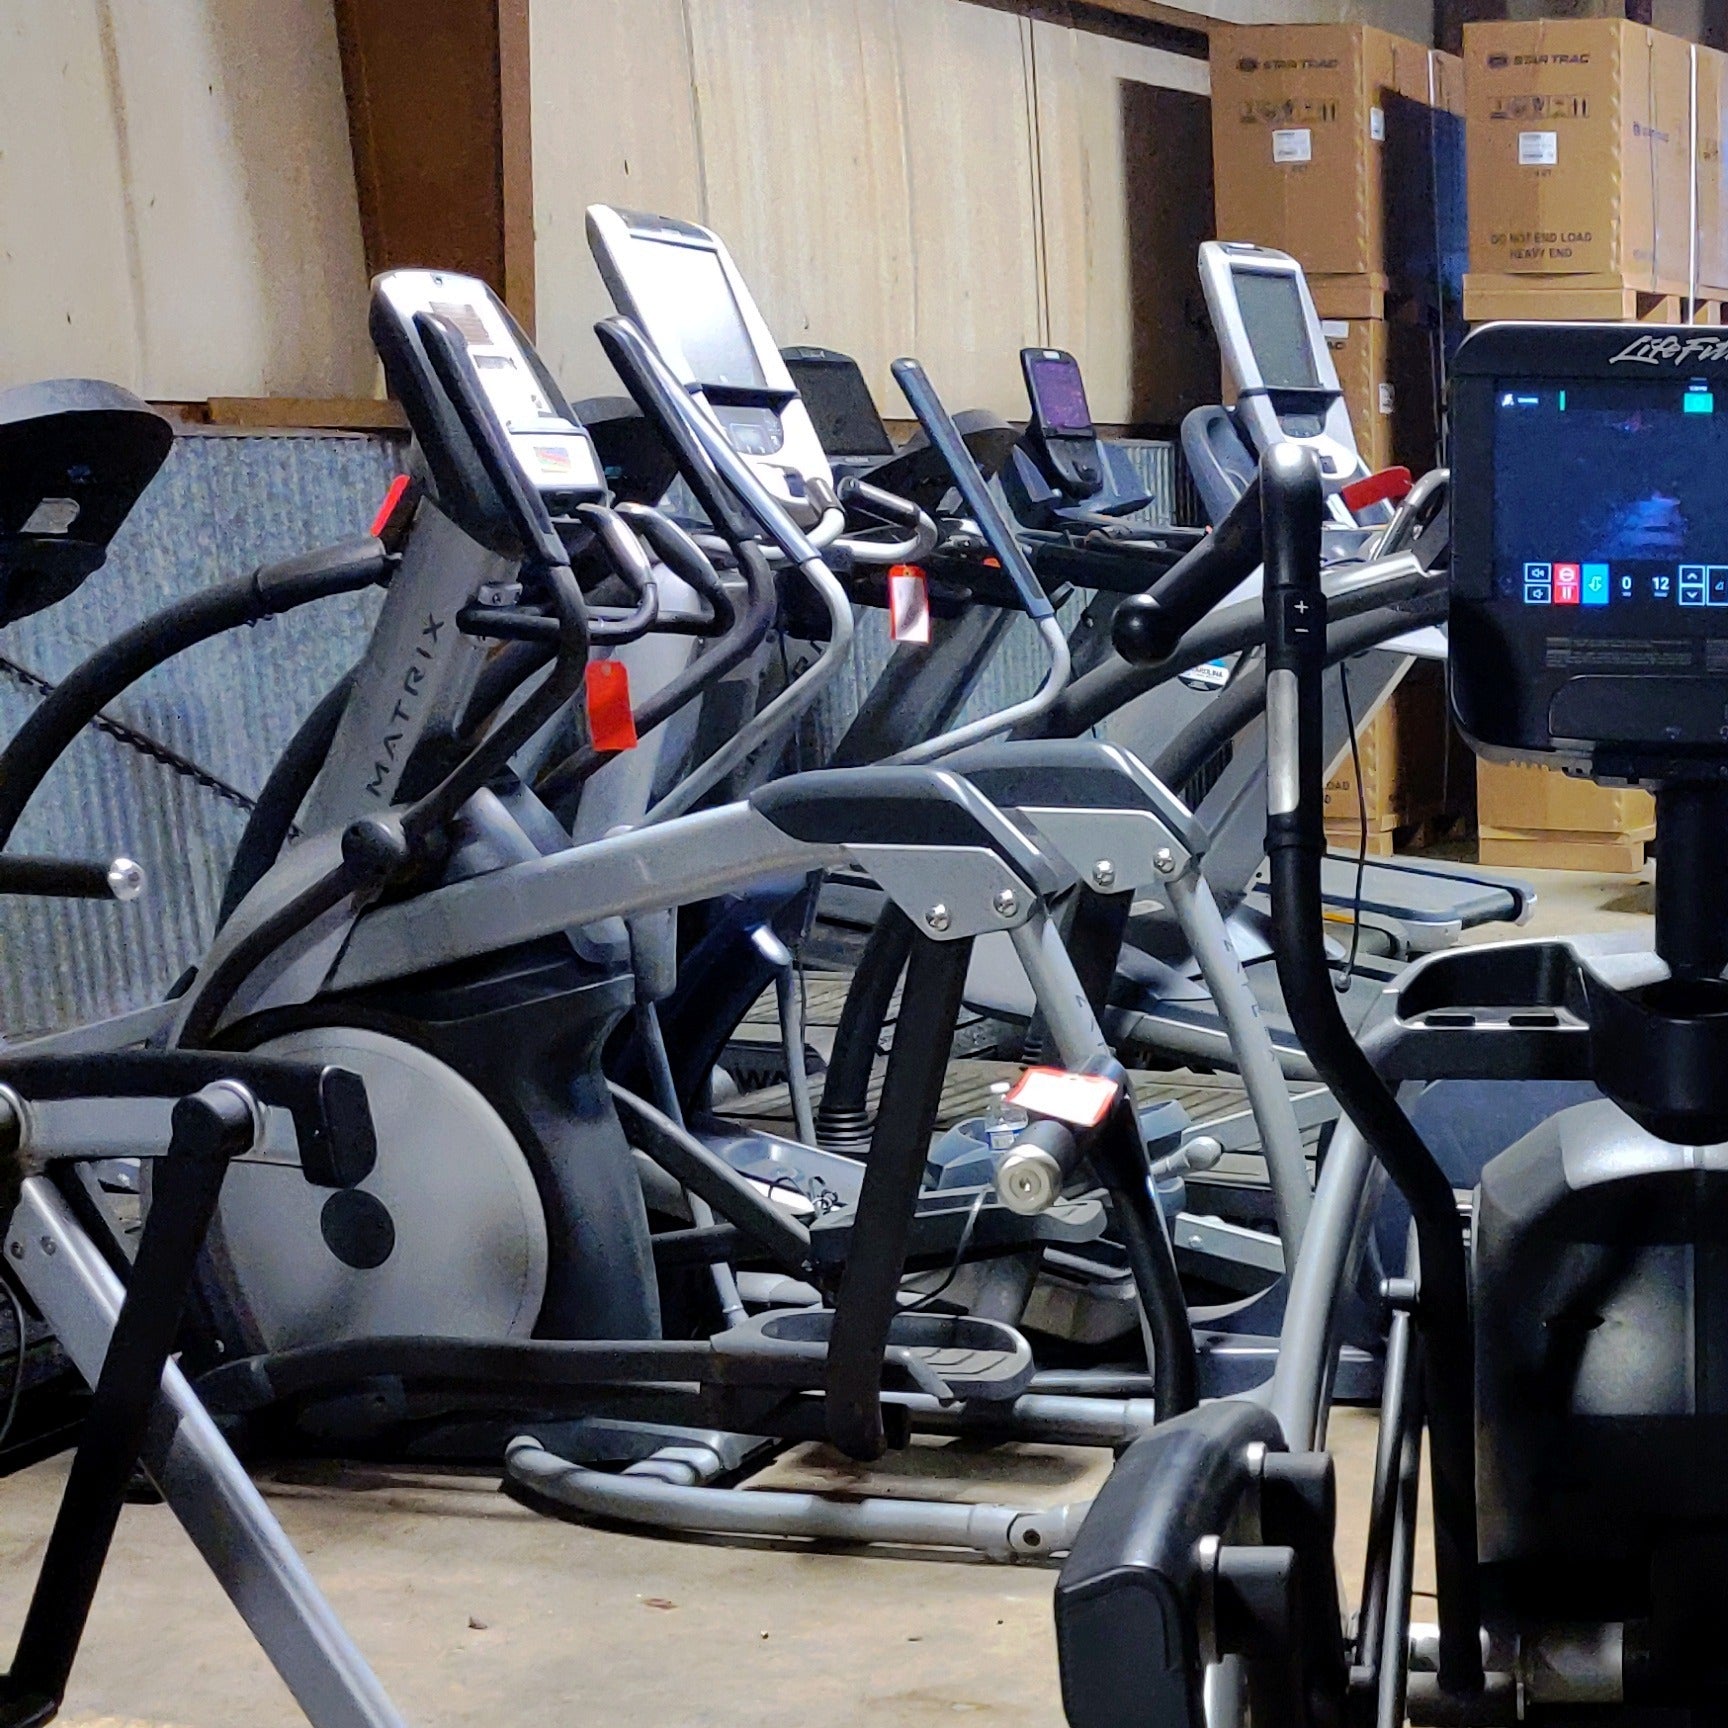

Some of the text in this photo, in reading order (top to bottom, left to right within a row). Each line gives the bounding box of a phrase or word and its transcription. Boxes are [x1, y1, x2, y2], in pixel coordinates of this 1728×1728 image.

[1513, 54, 1590, 66] STAR TRAC
[1509, 233, 1531, 244] NOT
[1534, 231, 1557, 243] END
[1560, 231, 1592, 243] LOAD
[1510, 247, 1573, 259] HEAVY END
[1622, 576, 1632, 590] 0
[1652, 576, 1670, 591] 12
[366, 611, 445, 798] MATRIX
